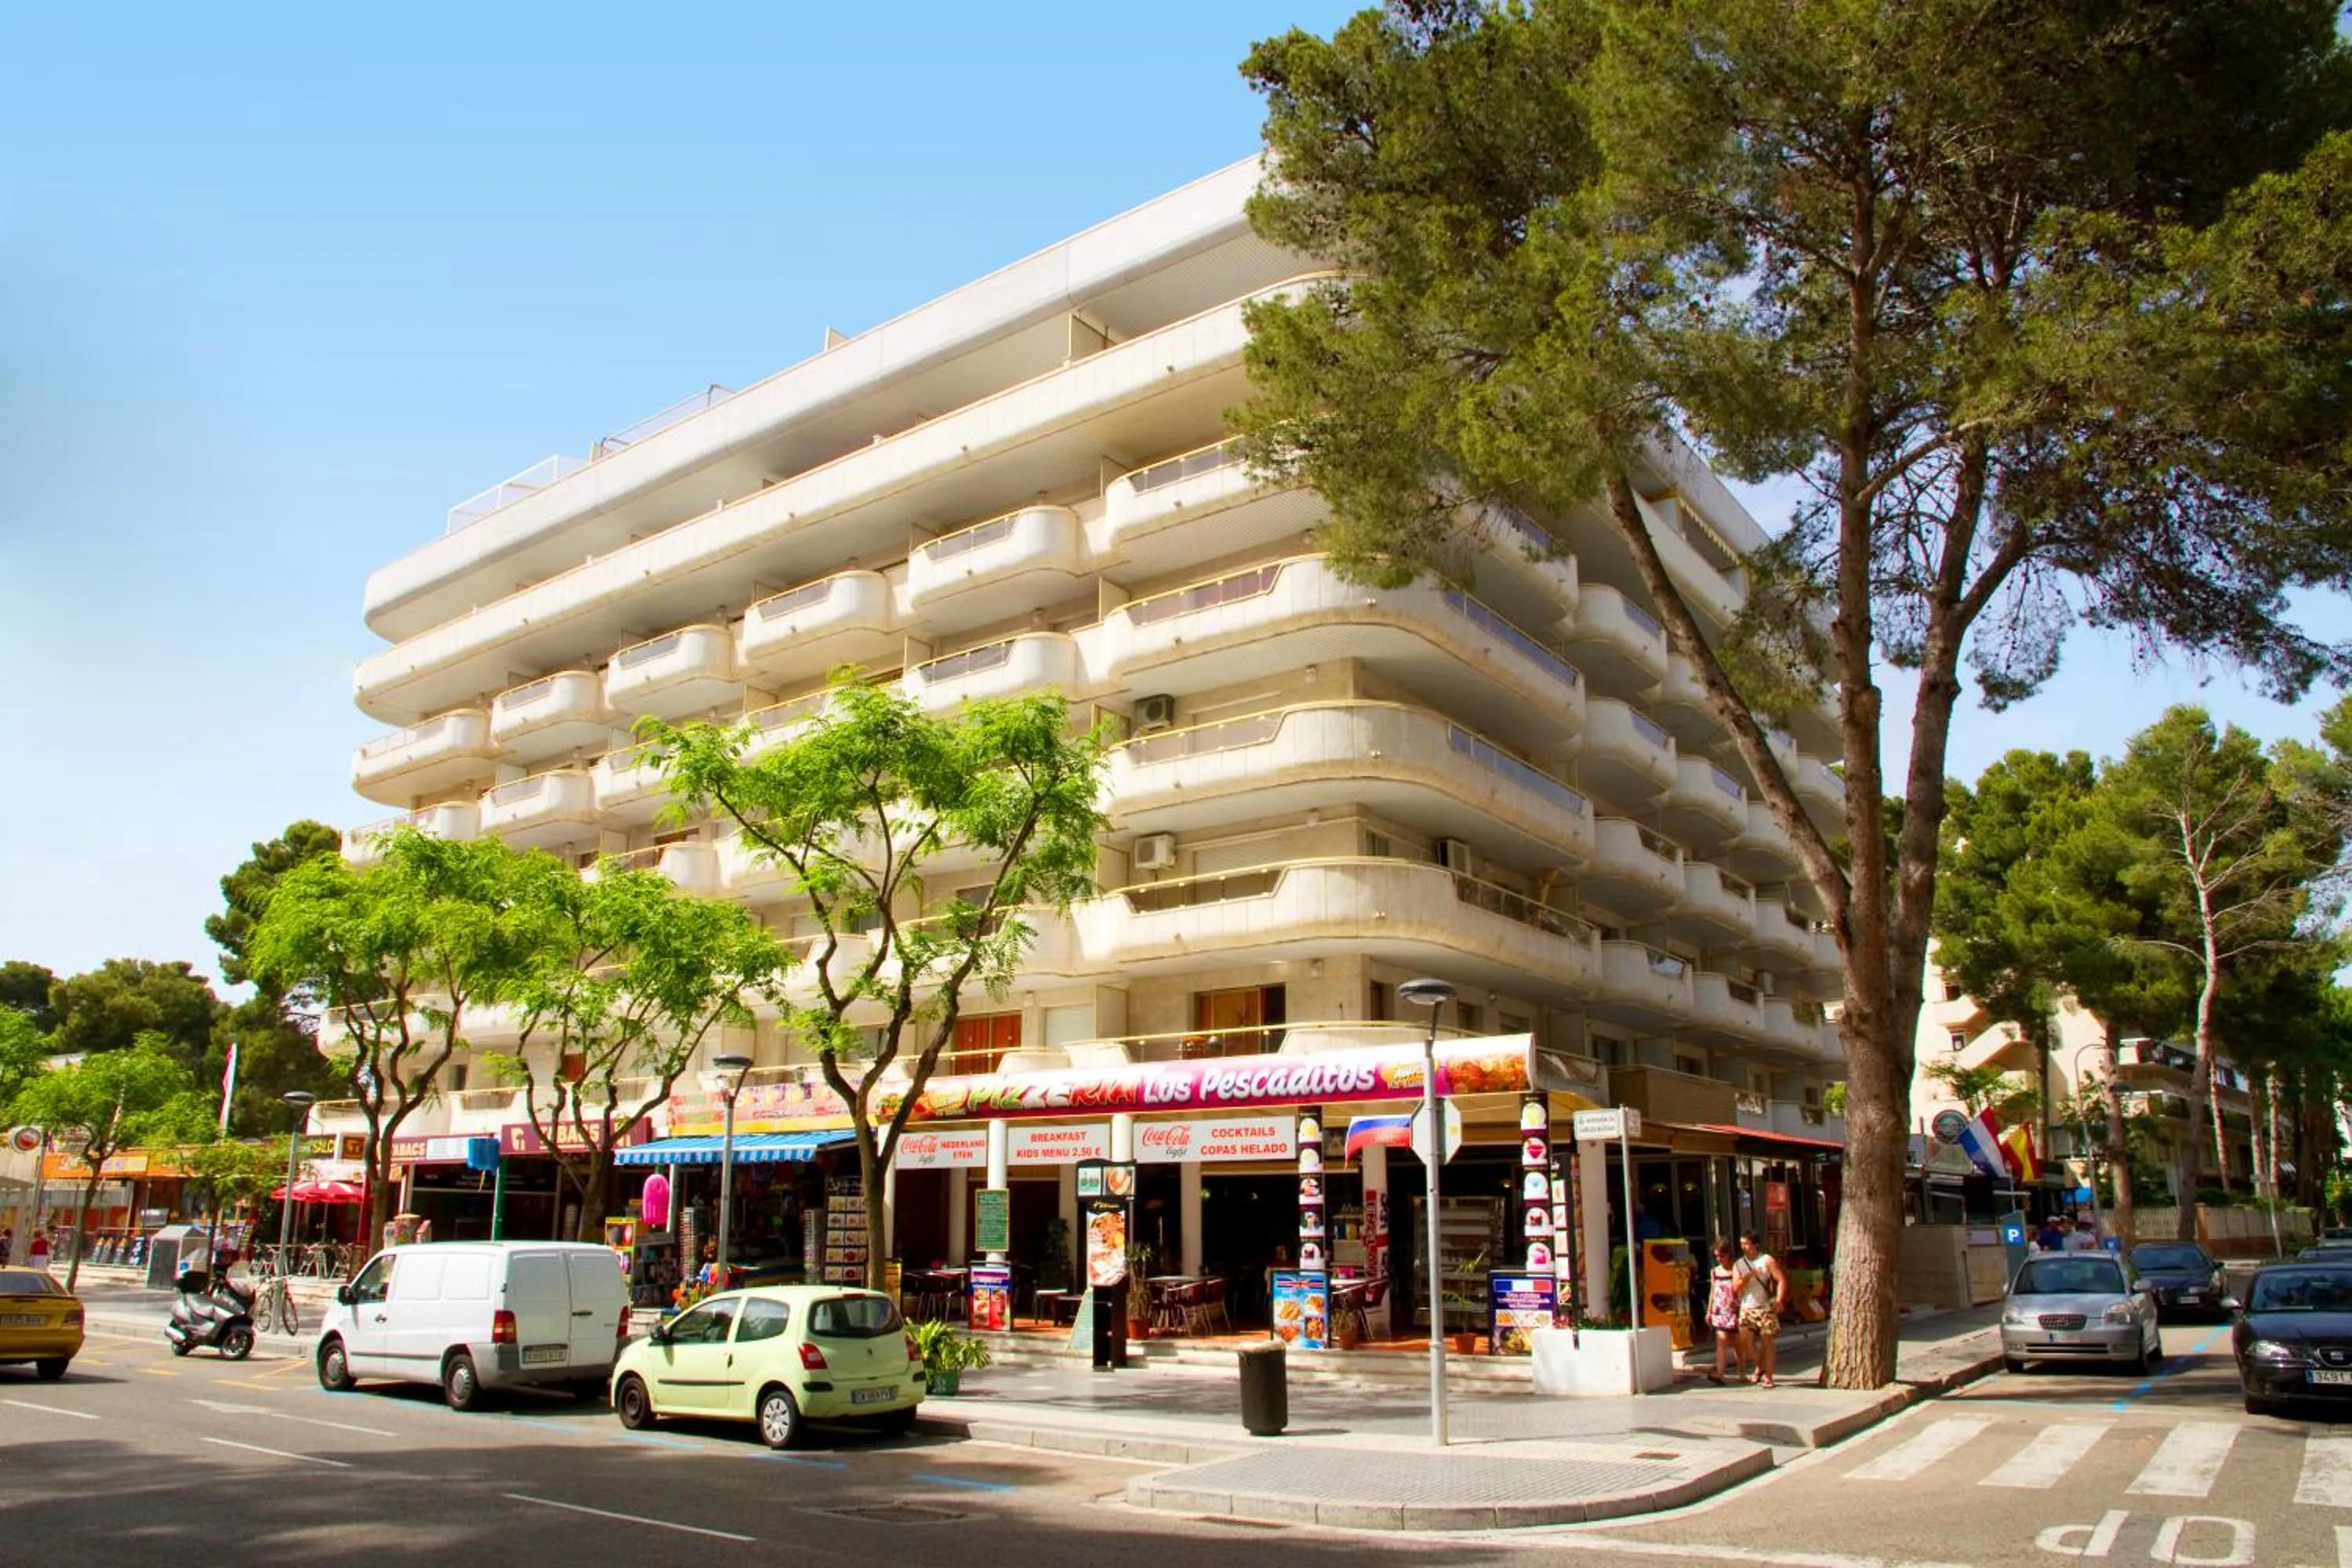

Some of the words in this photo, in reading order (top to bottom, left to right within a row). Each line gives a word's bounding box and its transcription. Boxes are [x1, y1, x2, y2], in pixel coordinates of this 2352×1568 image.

[1142, 1069, 1192, 1105] Los
[1199, 1062, 1377, 1103] Pescaditos
[1030, 1131, 1087, 1142] BREAKFAST
[1142, 1124, 1192, 1147] Coca-Cola
[1210, 1126, 1276, 1138] COCKTAILS
[1016, 1148, 1040, 1158] KIDS
[1041, 1147, 1070, 1157] MENU
[1200, 1143, 1237, 1156] COPAS
[1241, 1142, 1287, 1155] HELADO
[2008, 1229, 2020, 1243] P
